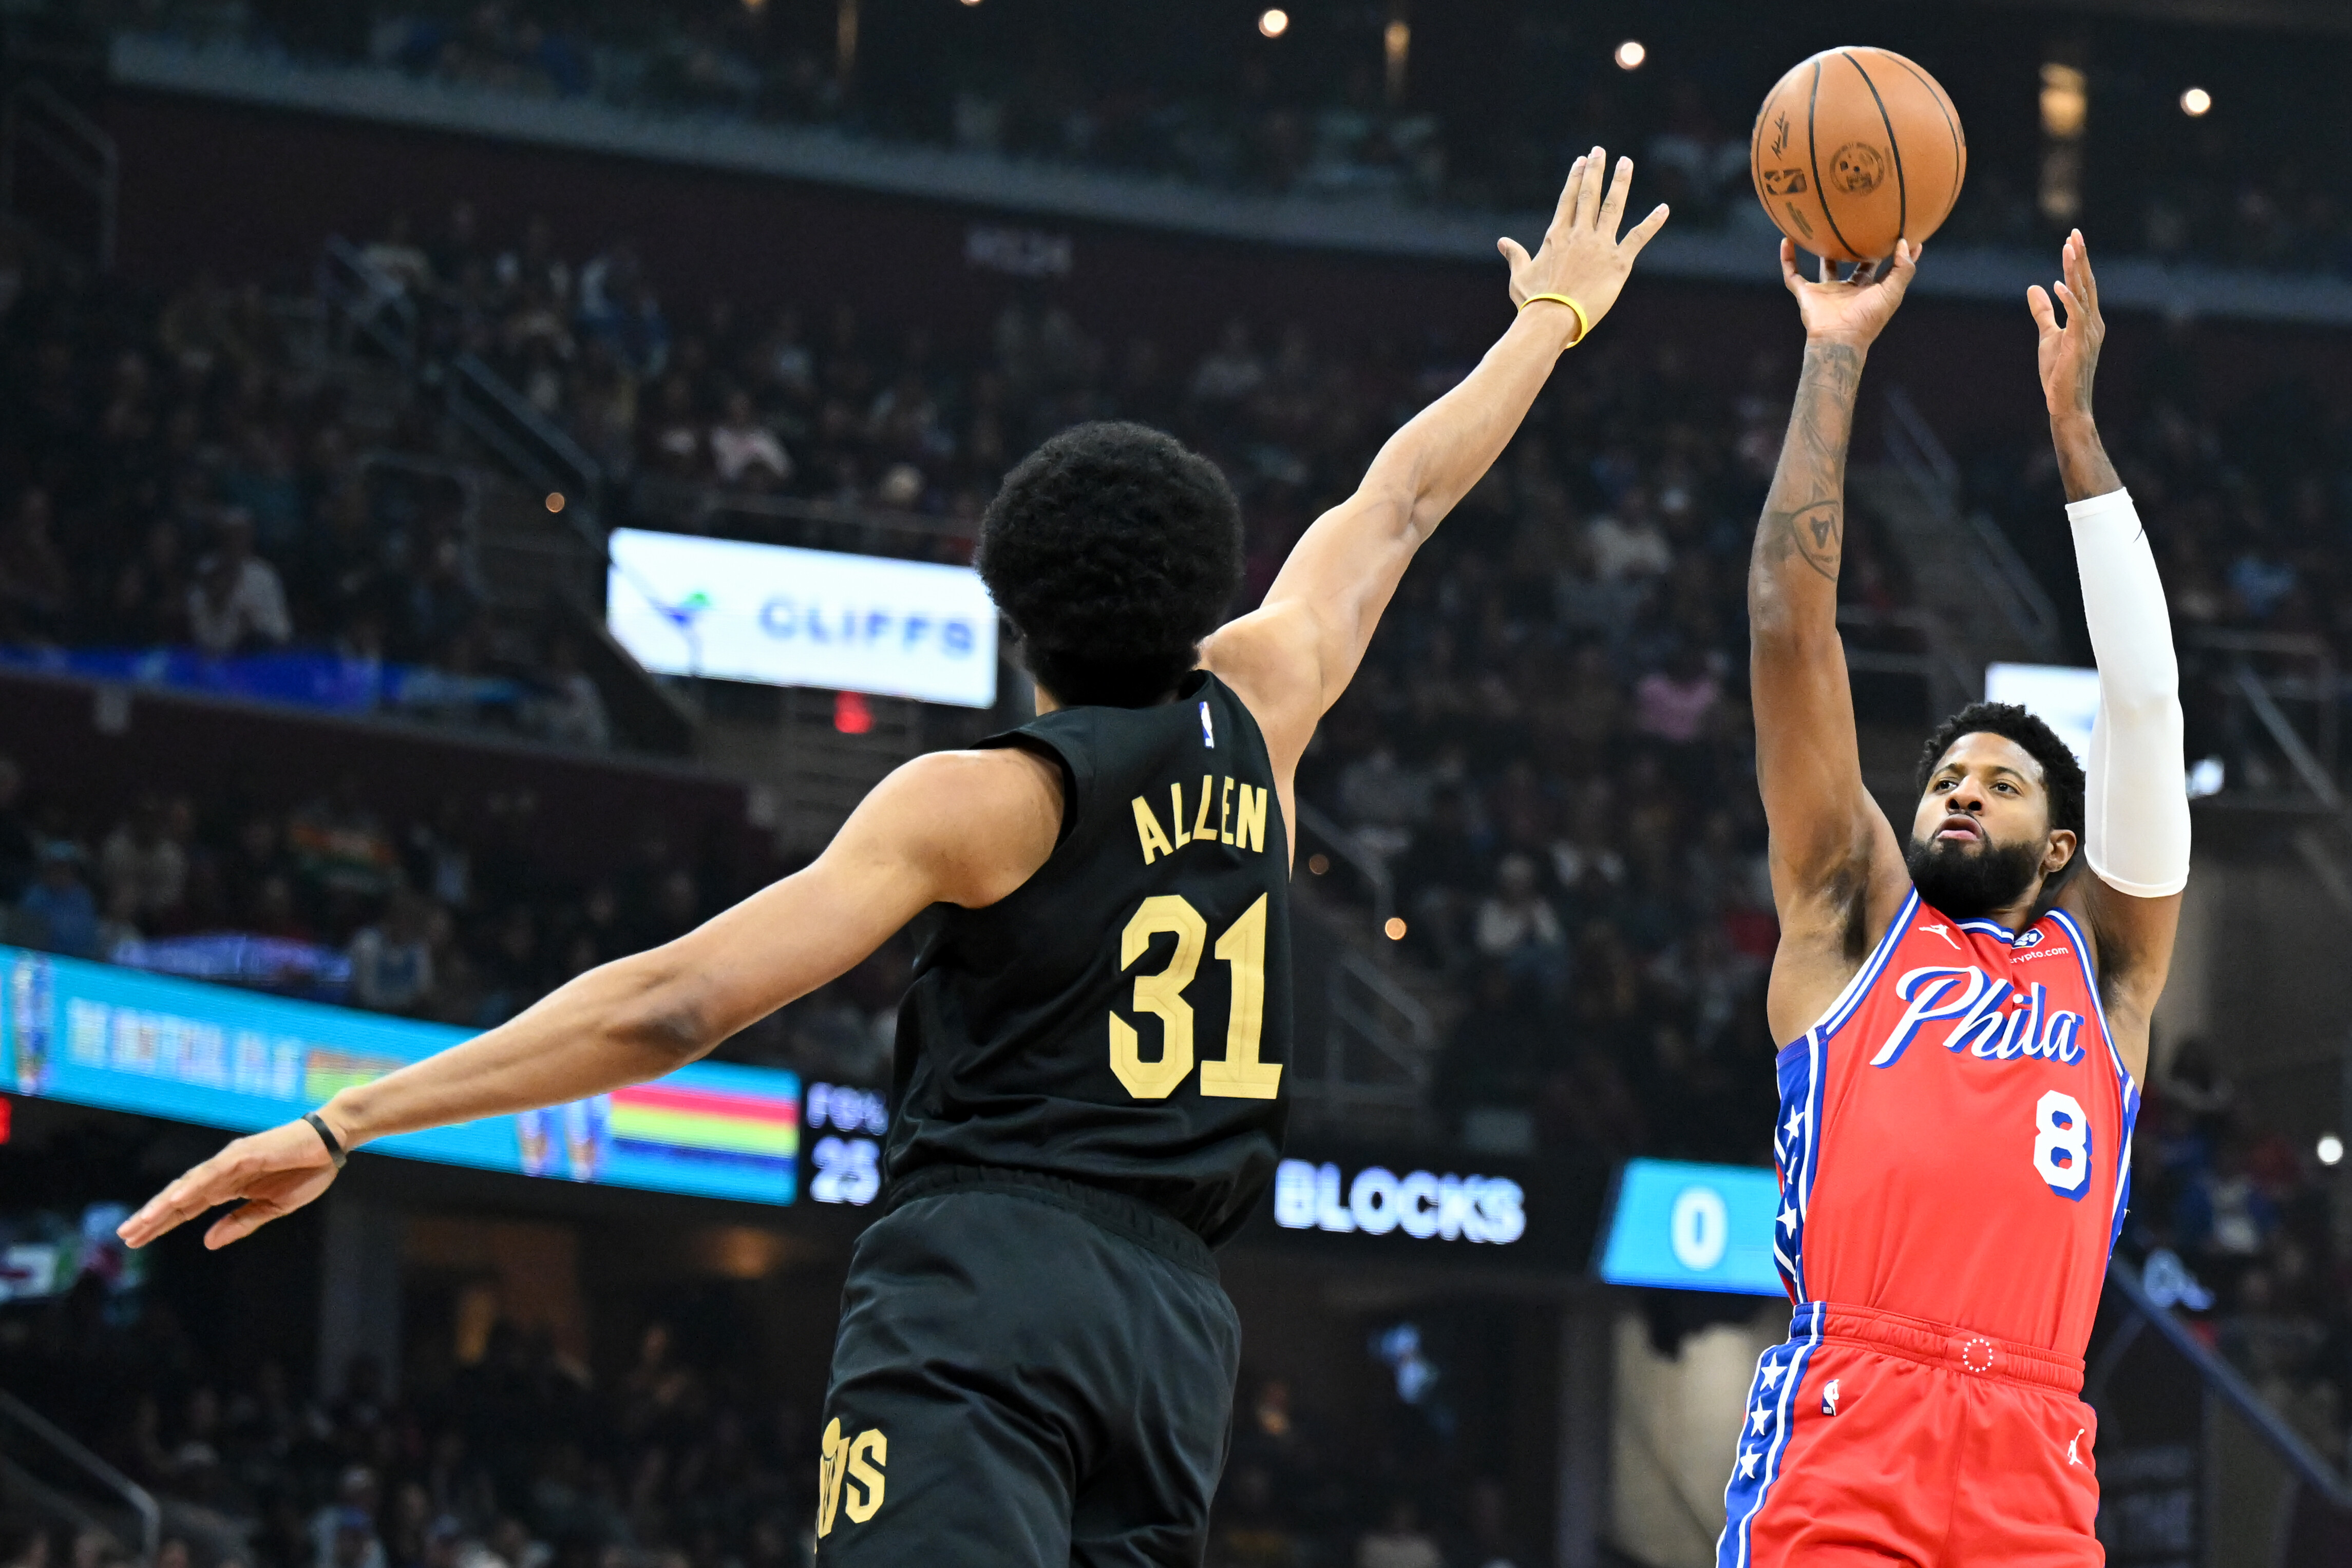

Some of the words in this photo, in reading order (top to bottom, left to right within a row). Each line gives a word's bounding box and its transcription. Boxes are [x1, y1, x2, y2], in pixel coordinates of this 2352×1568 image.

[760, 594, 975, 658] CLIFFS
[1131, 775, 1267, 865] ALLEN
[1109, 892, 1283, 1099] 31
[1870, 965, 2085, 1069] Phila
[810, 1136, 881, 1206] 25
[2033, 1089, 2092, 1202] 8
[1274, 1158, 1526, 1245] BLOCKS
[1671, 1185, 1728, 1271] 0
